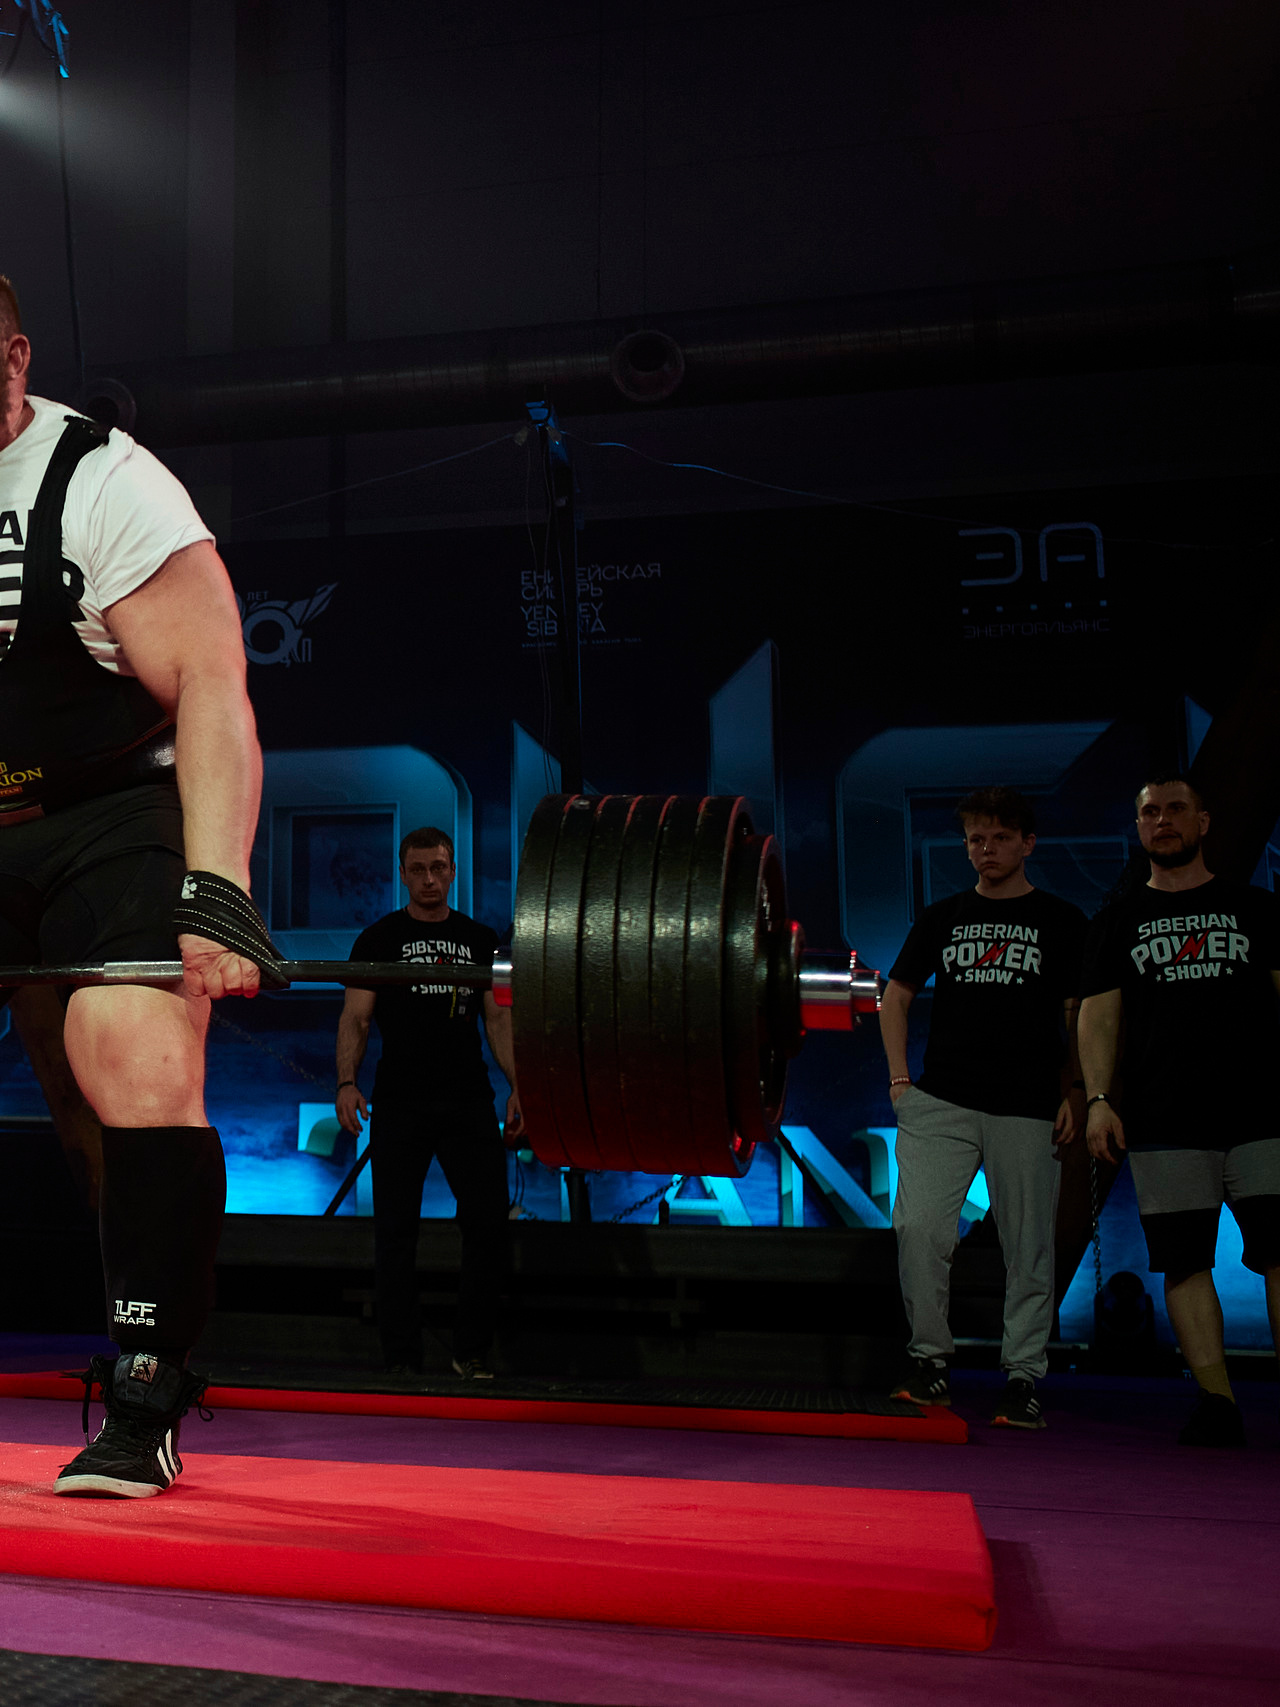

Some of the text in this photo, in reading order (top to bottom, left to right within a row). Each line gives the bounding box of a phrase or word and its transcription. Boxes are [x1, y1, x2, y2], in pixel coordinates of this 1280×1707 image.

[520, 562, 662, 586] ЕНИЕЙСКАЯ
[951, 923, 1039, 944] SIBERIAN
[1138, 913, 1239, 940] SIBERIAN
[942, 941, 1043, 975] POWER
[1130, 930, 1250, 976] POWER
[964, 968, 1014, 985] SHOW
[1163, 962, 1222, 982] SHOW
[113, 1314, 156, 1327] WRAPS
